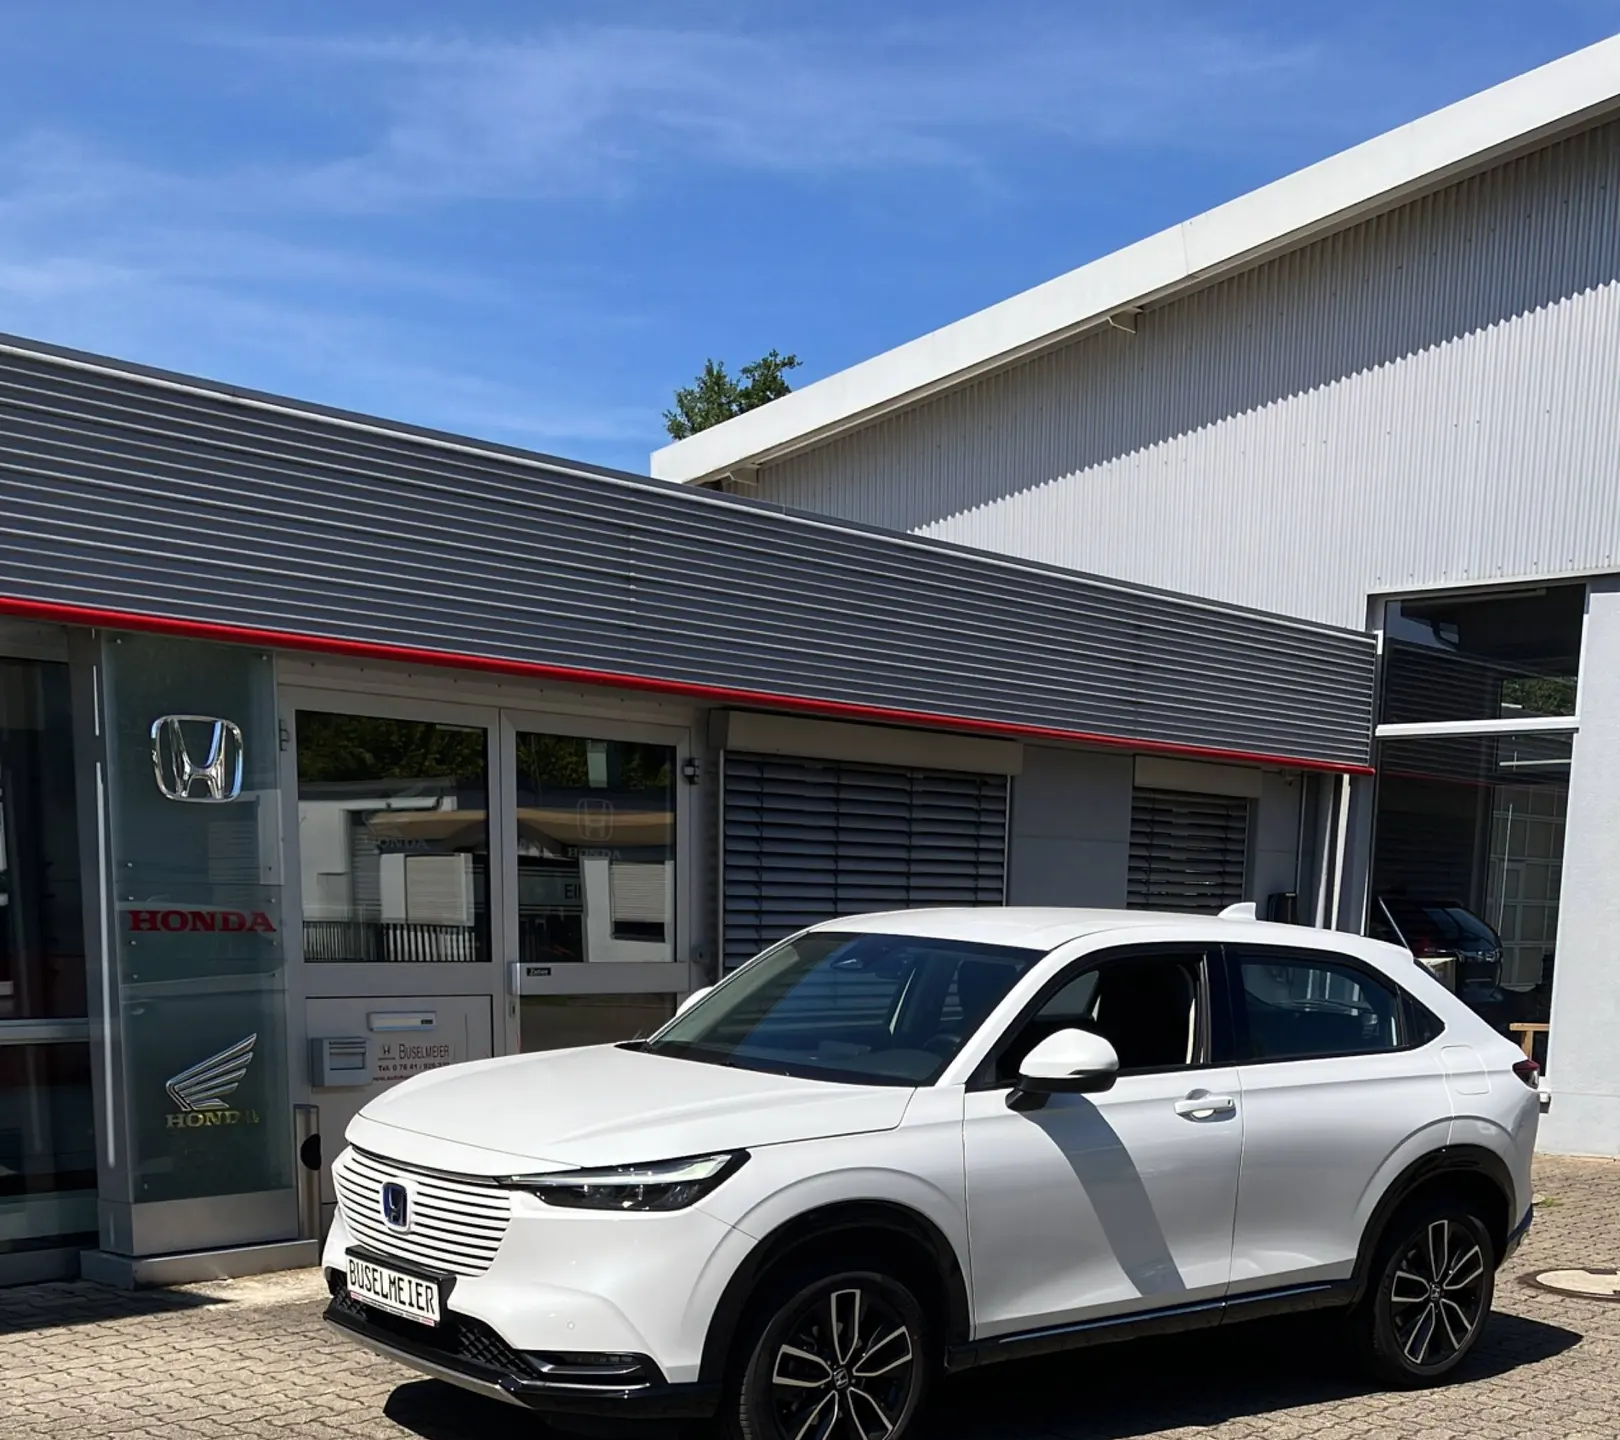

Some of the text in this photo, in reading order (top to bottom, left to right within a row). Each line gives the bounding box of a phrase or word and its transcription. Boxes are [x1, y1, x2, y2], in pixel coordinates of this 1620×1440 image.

[568, 847, 621, 859] HONDA
[128, 910, 276, 932] HONDA
[349, 1258, 435, 1315] BUSELMEIER
